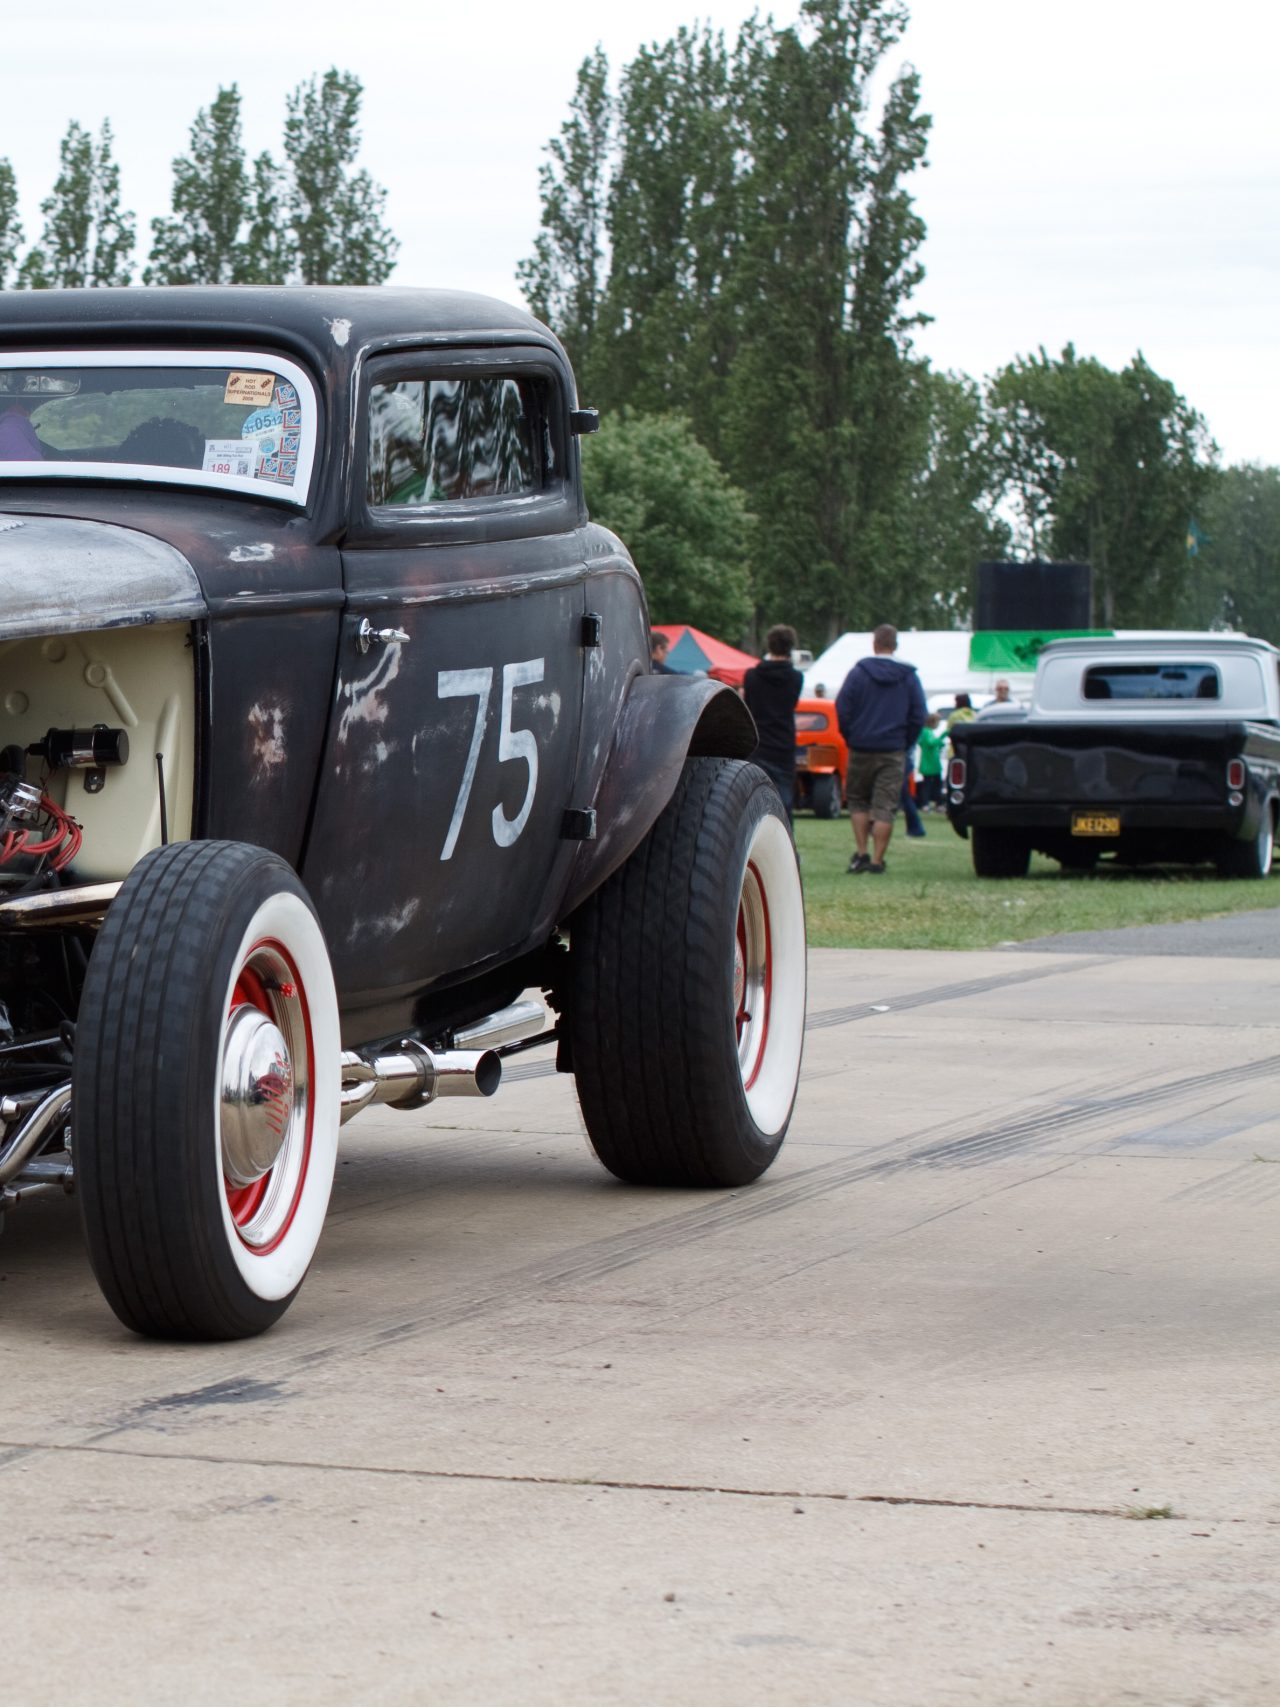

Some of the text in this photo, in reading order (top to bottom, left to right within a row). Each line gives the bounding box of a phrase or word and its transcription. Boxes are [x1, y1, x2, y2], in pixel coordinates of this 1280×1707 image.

[228, 389, 271, 397] SUPERNATIONALS
[211, 463, 230, 474] 189
[437, 657, 545, 861] 75
